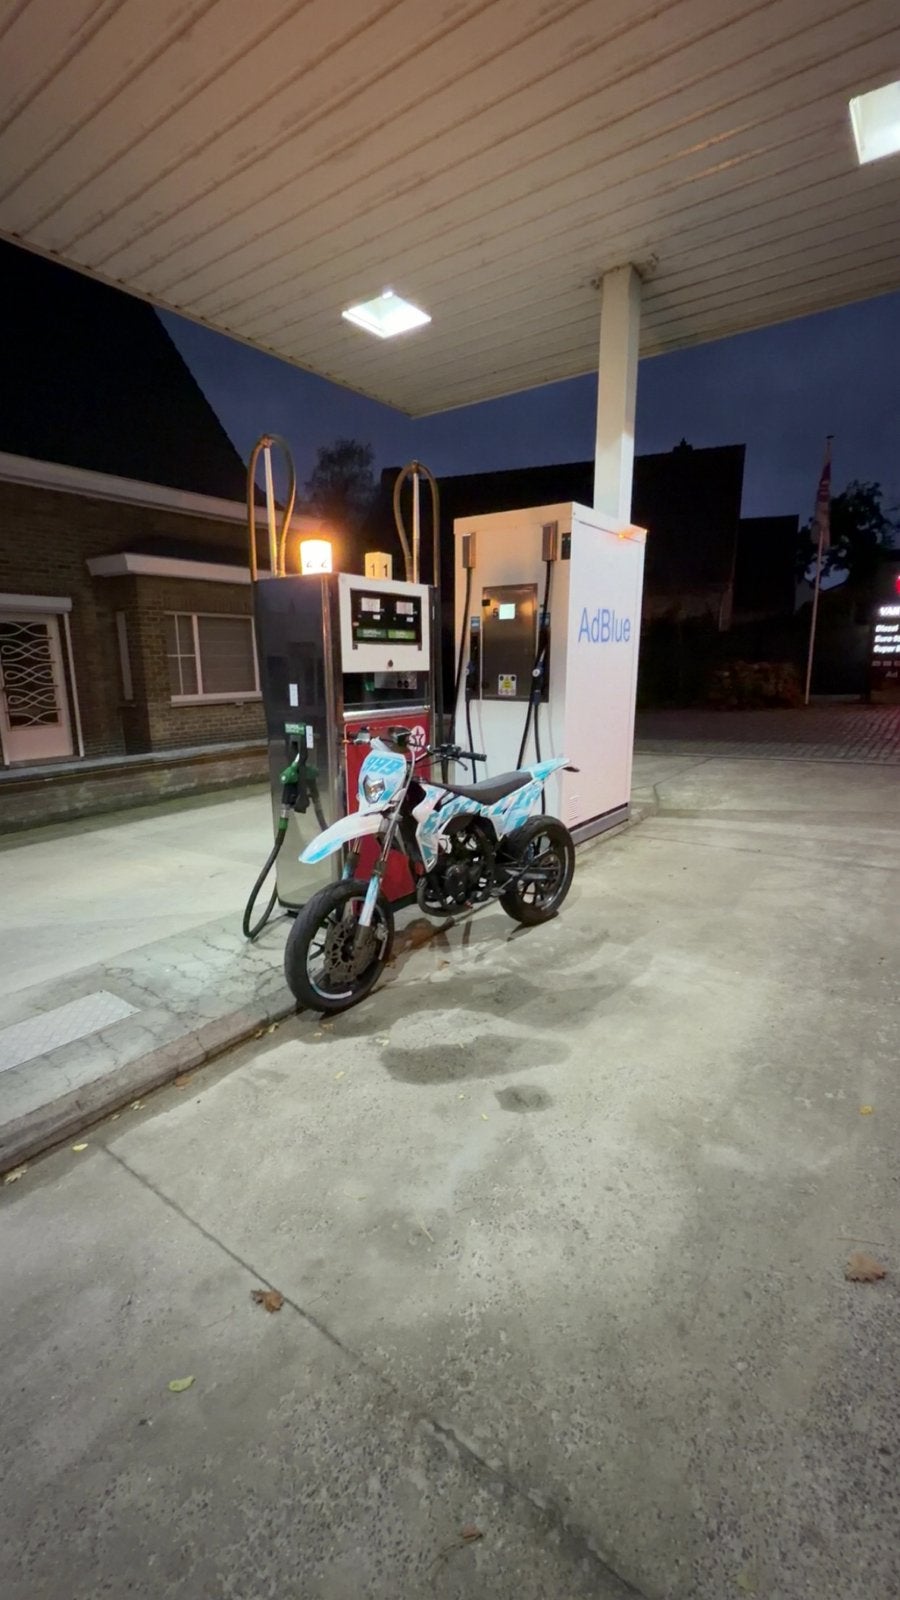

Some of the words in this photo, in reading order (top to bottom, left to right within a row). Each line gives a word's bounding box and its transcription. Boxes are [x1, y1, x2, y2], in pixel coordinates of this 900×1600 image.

[370, 564, 376, 576] 1
[383, 564, 389, 578] 1
[578, 607, 631, 643] AdBlue
[875, 624, 899, 632] Diesel
